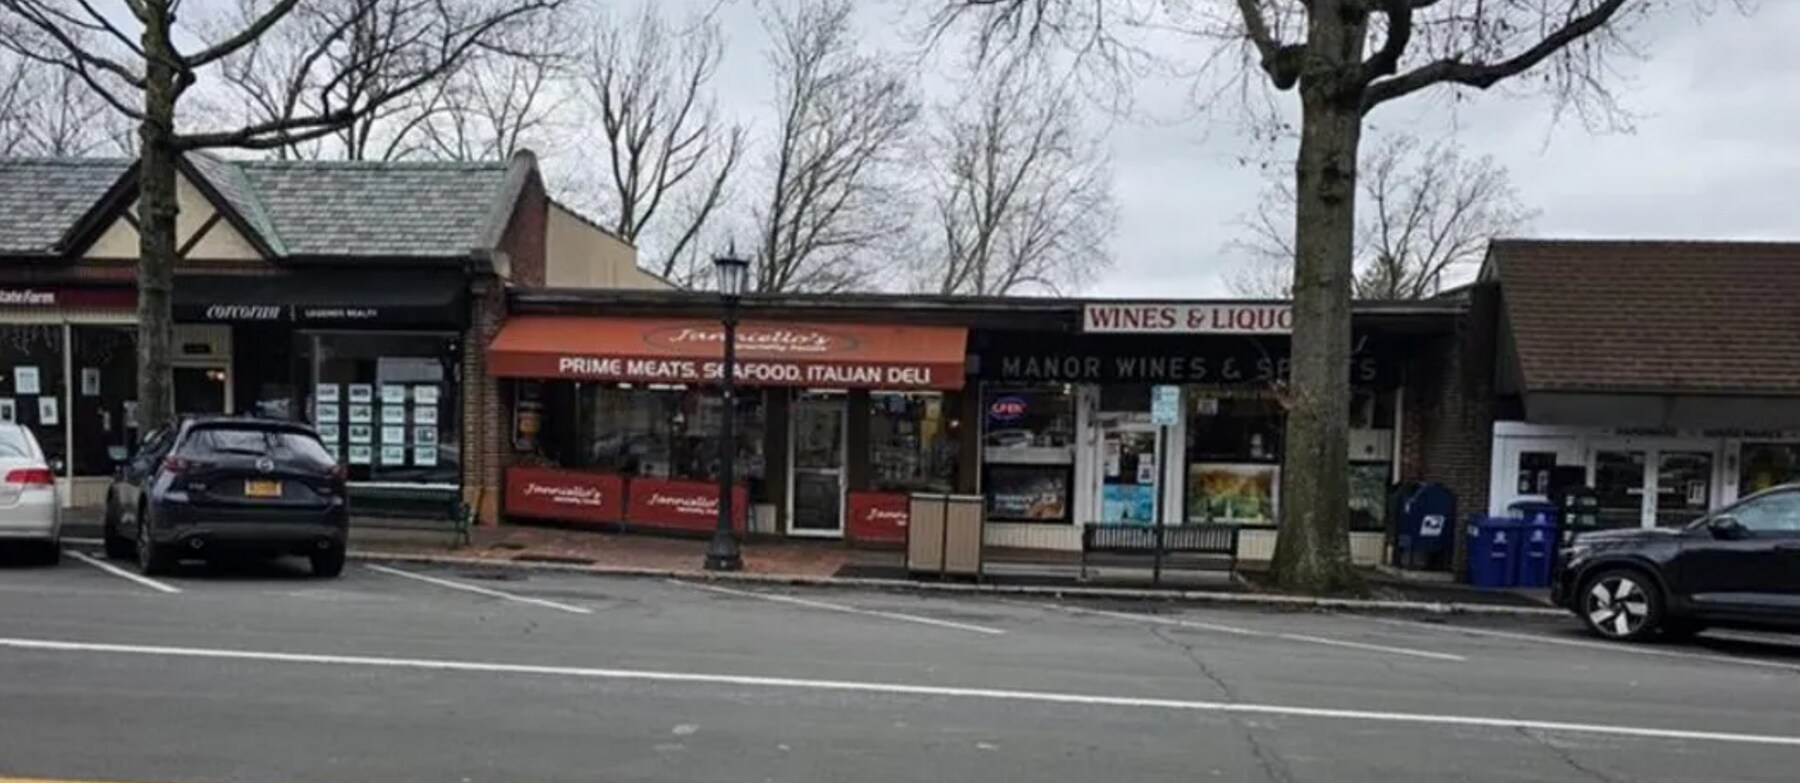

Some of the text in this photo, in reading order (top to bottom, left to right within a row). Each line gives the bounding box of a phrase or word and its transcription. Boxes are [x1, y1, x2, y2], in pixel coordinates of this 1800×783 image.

[1089, 307, 1292, 331] WINES & LIQUO
[558, 357, 622, 375] PRIME
[807, 366, 882, 384] ITALIAN
[887, 368, 931, 384] DELI
[1002, 356, 1099, 378] MANOR
[1116, 357, 1207, 379] WINES
[1222, 358, 1241, 379] &
